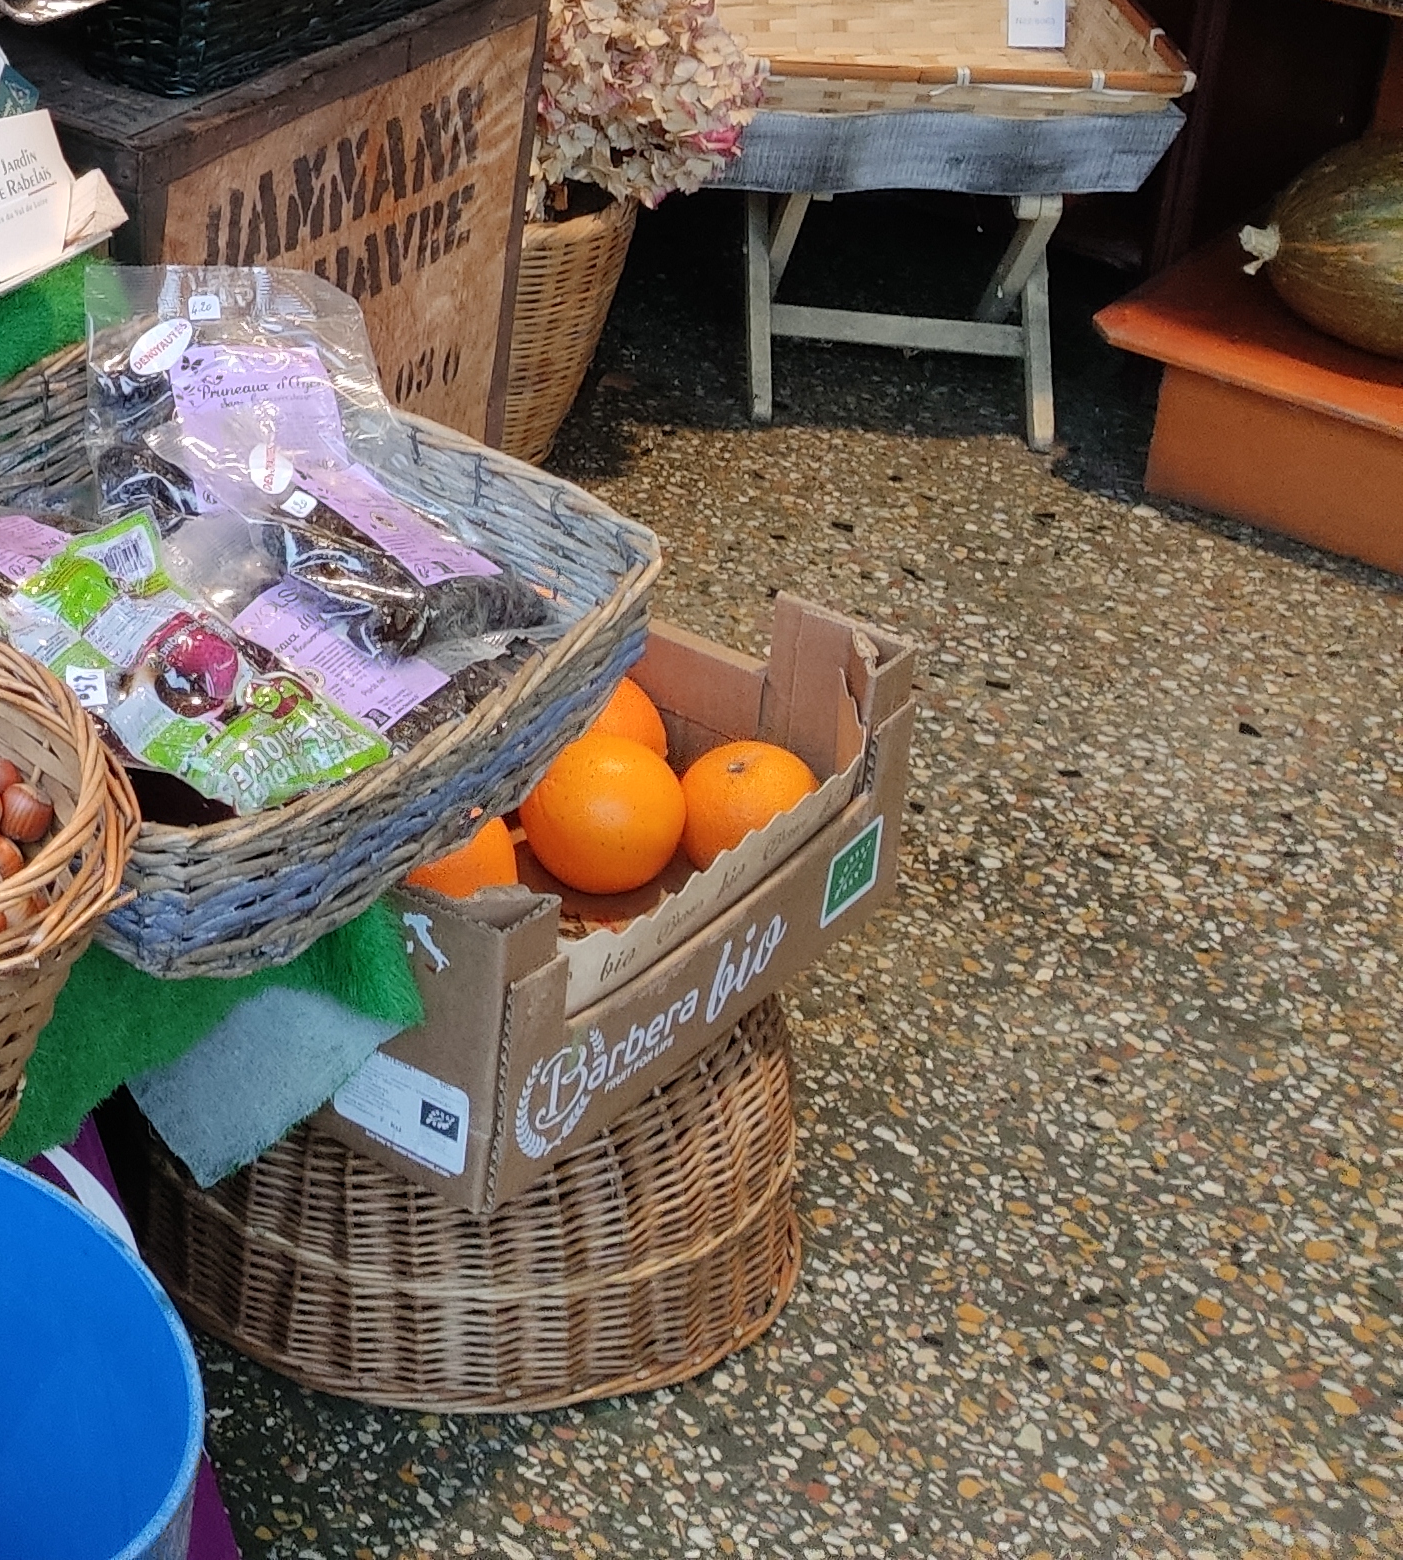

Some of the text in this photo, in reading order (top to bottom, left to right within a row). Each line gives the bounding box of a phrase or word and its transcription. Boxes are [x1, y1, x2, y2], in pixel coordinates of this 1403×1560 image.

[5, 211, 15, 221] du
[14, 207, 26, 219] Val
[25, 204, 35, 216] de
[34, 197, 50, 213] Loire
[196, 380, 270, 401] Pruneaux
[600, 946, 637, 983] bio
[534, 987, 700, 1131] Barbera
[705, 913, 789, 1024] bio
[604, 1065, 634, 1094] FRUIT
